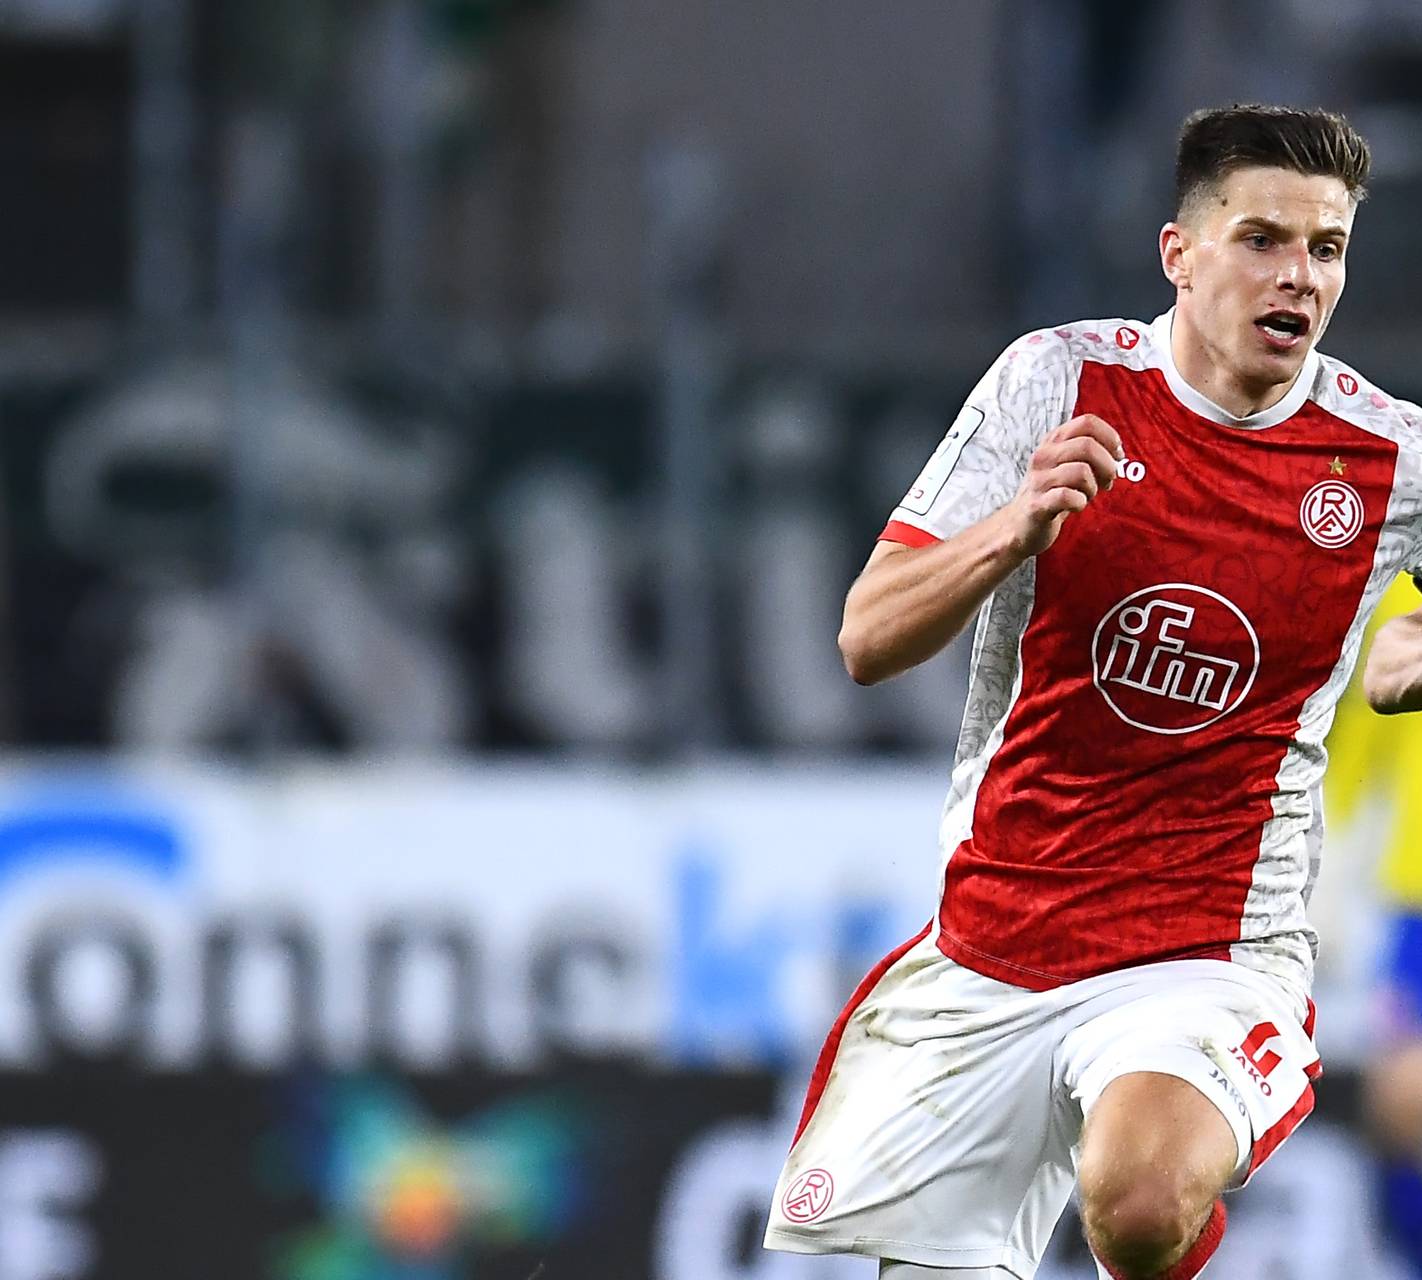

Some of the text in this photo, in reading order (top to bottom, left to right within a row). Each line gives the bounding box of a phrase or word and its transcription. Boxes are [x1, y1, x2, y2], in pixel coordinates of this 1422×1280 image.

[1101, 599, 1240, 711] ifm
[1208, 1069, 1246, 1117] JAKO
[1227, 1046, 1272, 1097] JAKO
